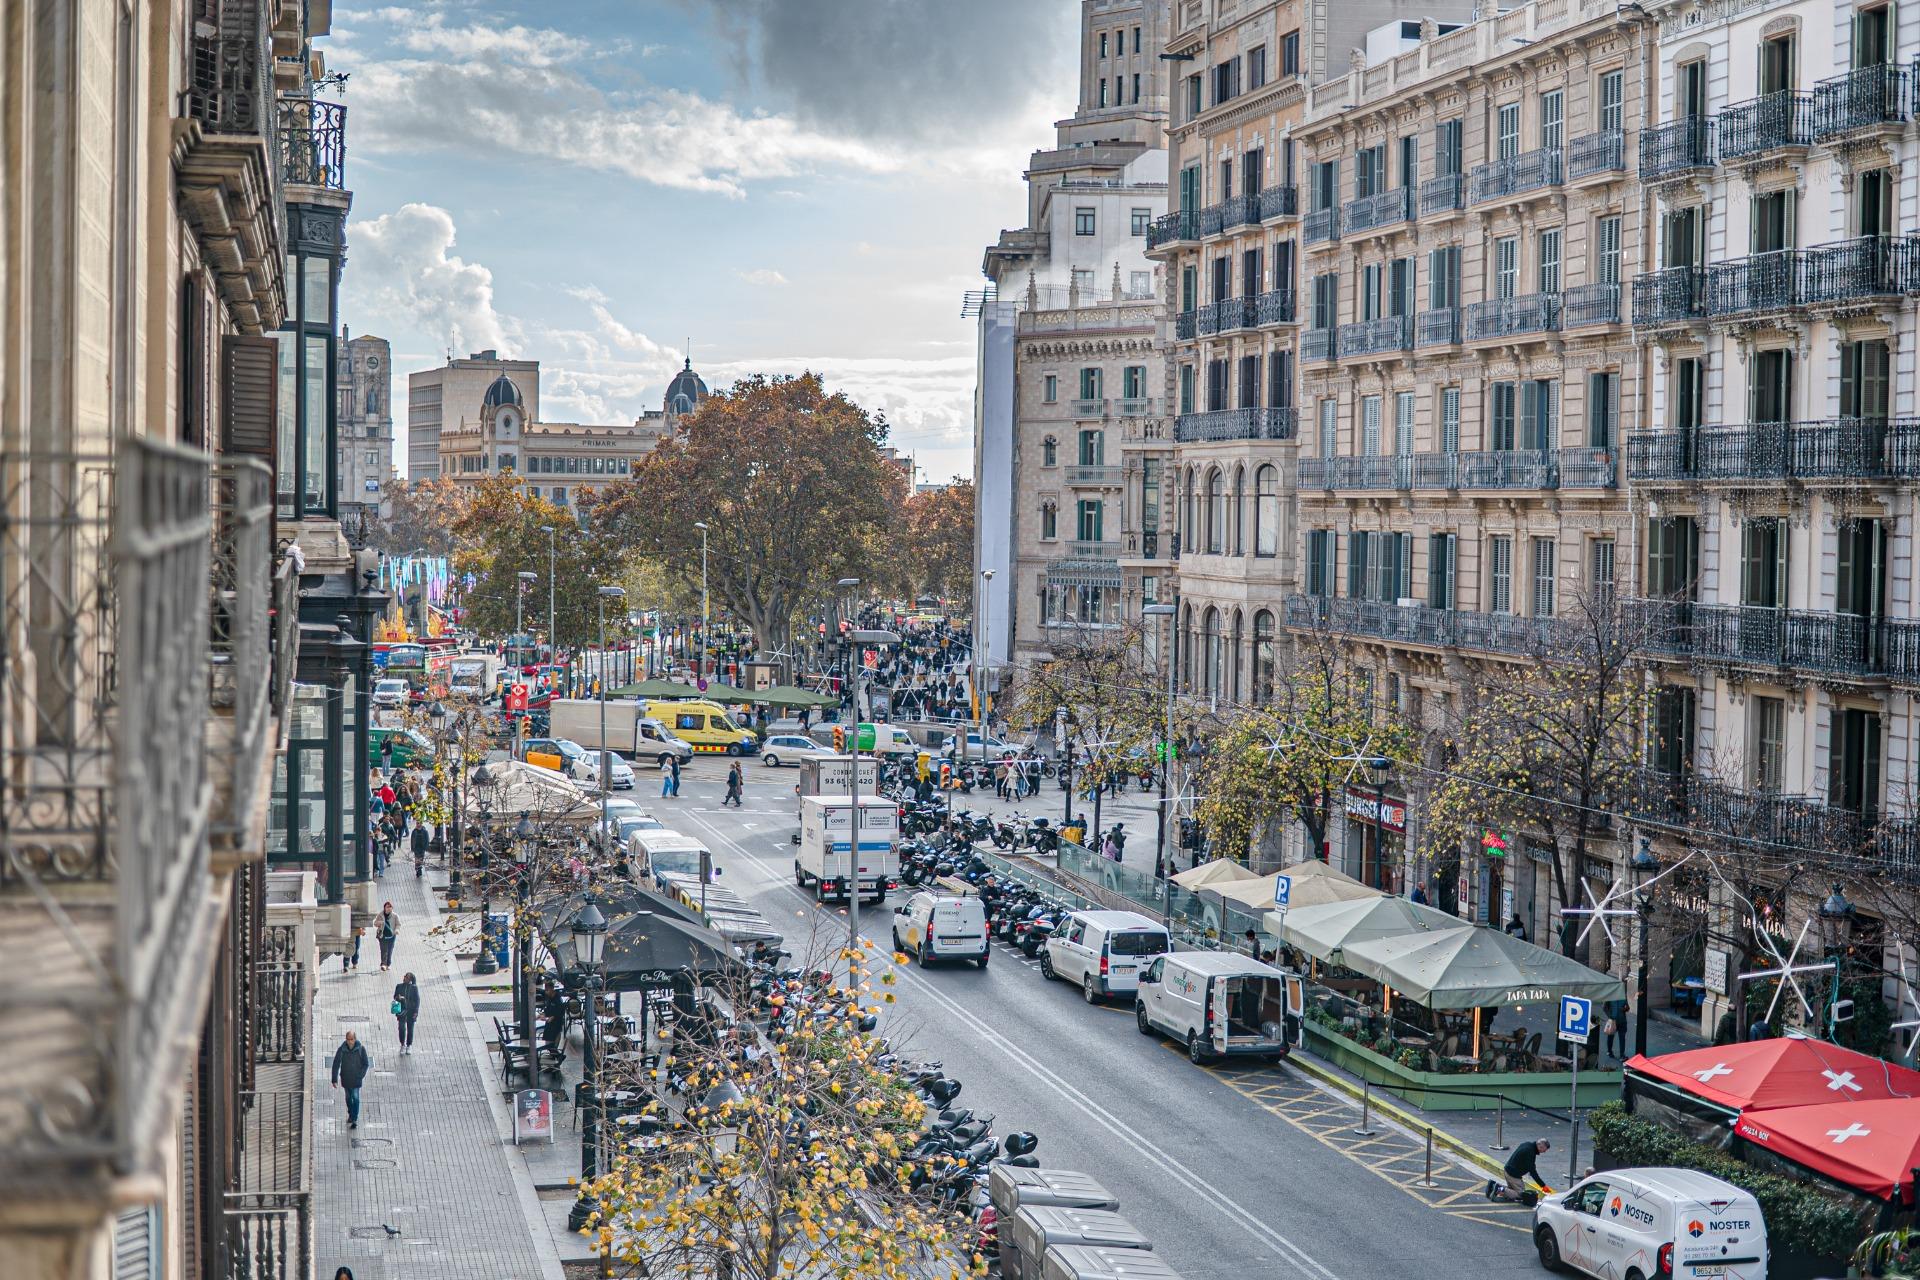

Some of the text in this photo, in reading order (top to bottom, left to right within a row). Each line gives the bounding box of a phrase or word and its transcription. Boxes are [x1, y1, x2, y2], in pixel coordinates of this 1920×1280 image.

[1277, 878, 1287, 901] P
[1507, 989, 1550, 1001] TAPA TAPA
[1565, 1001, 1583, 1029] P
[1624, 1203, 1654, 1227] NOSTER
[1709, 1220, 1751, 1231] NOSTER
